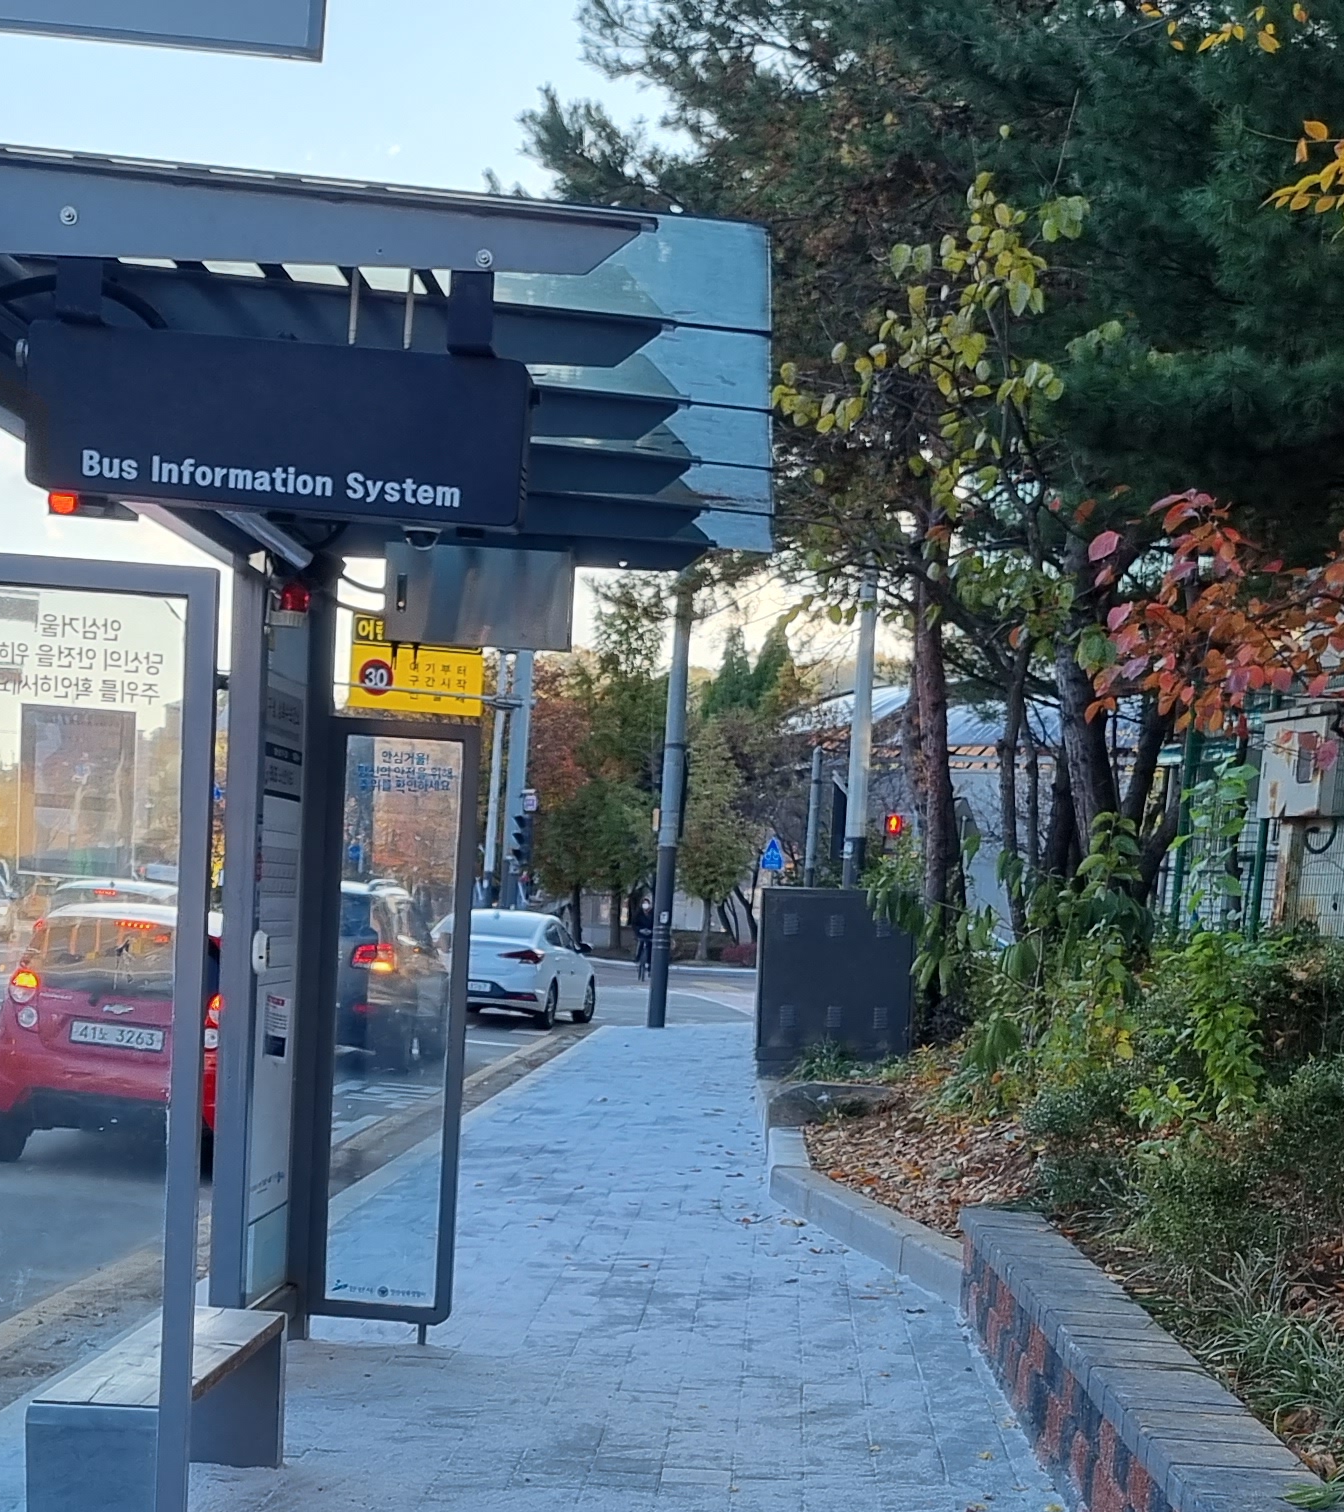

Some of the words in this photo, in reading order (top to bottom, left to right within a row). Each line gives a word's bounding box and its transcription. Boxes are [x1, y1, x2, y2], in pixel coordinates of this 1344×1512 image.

[80, 448, 139, 482] Bus
[149, 454, 335, 499] Information
[345, 470, 462, 510] System
[364, 667, 389, 688] 30
[381, 750, 430, 765] 안심거울!
[393, 766, 427, 780] 안전을
[394, 779, 450, 794] 확인하세요
[115, 1028, 156, 1047] 3263
